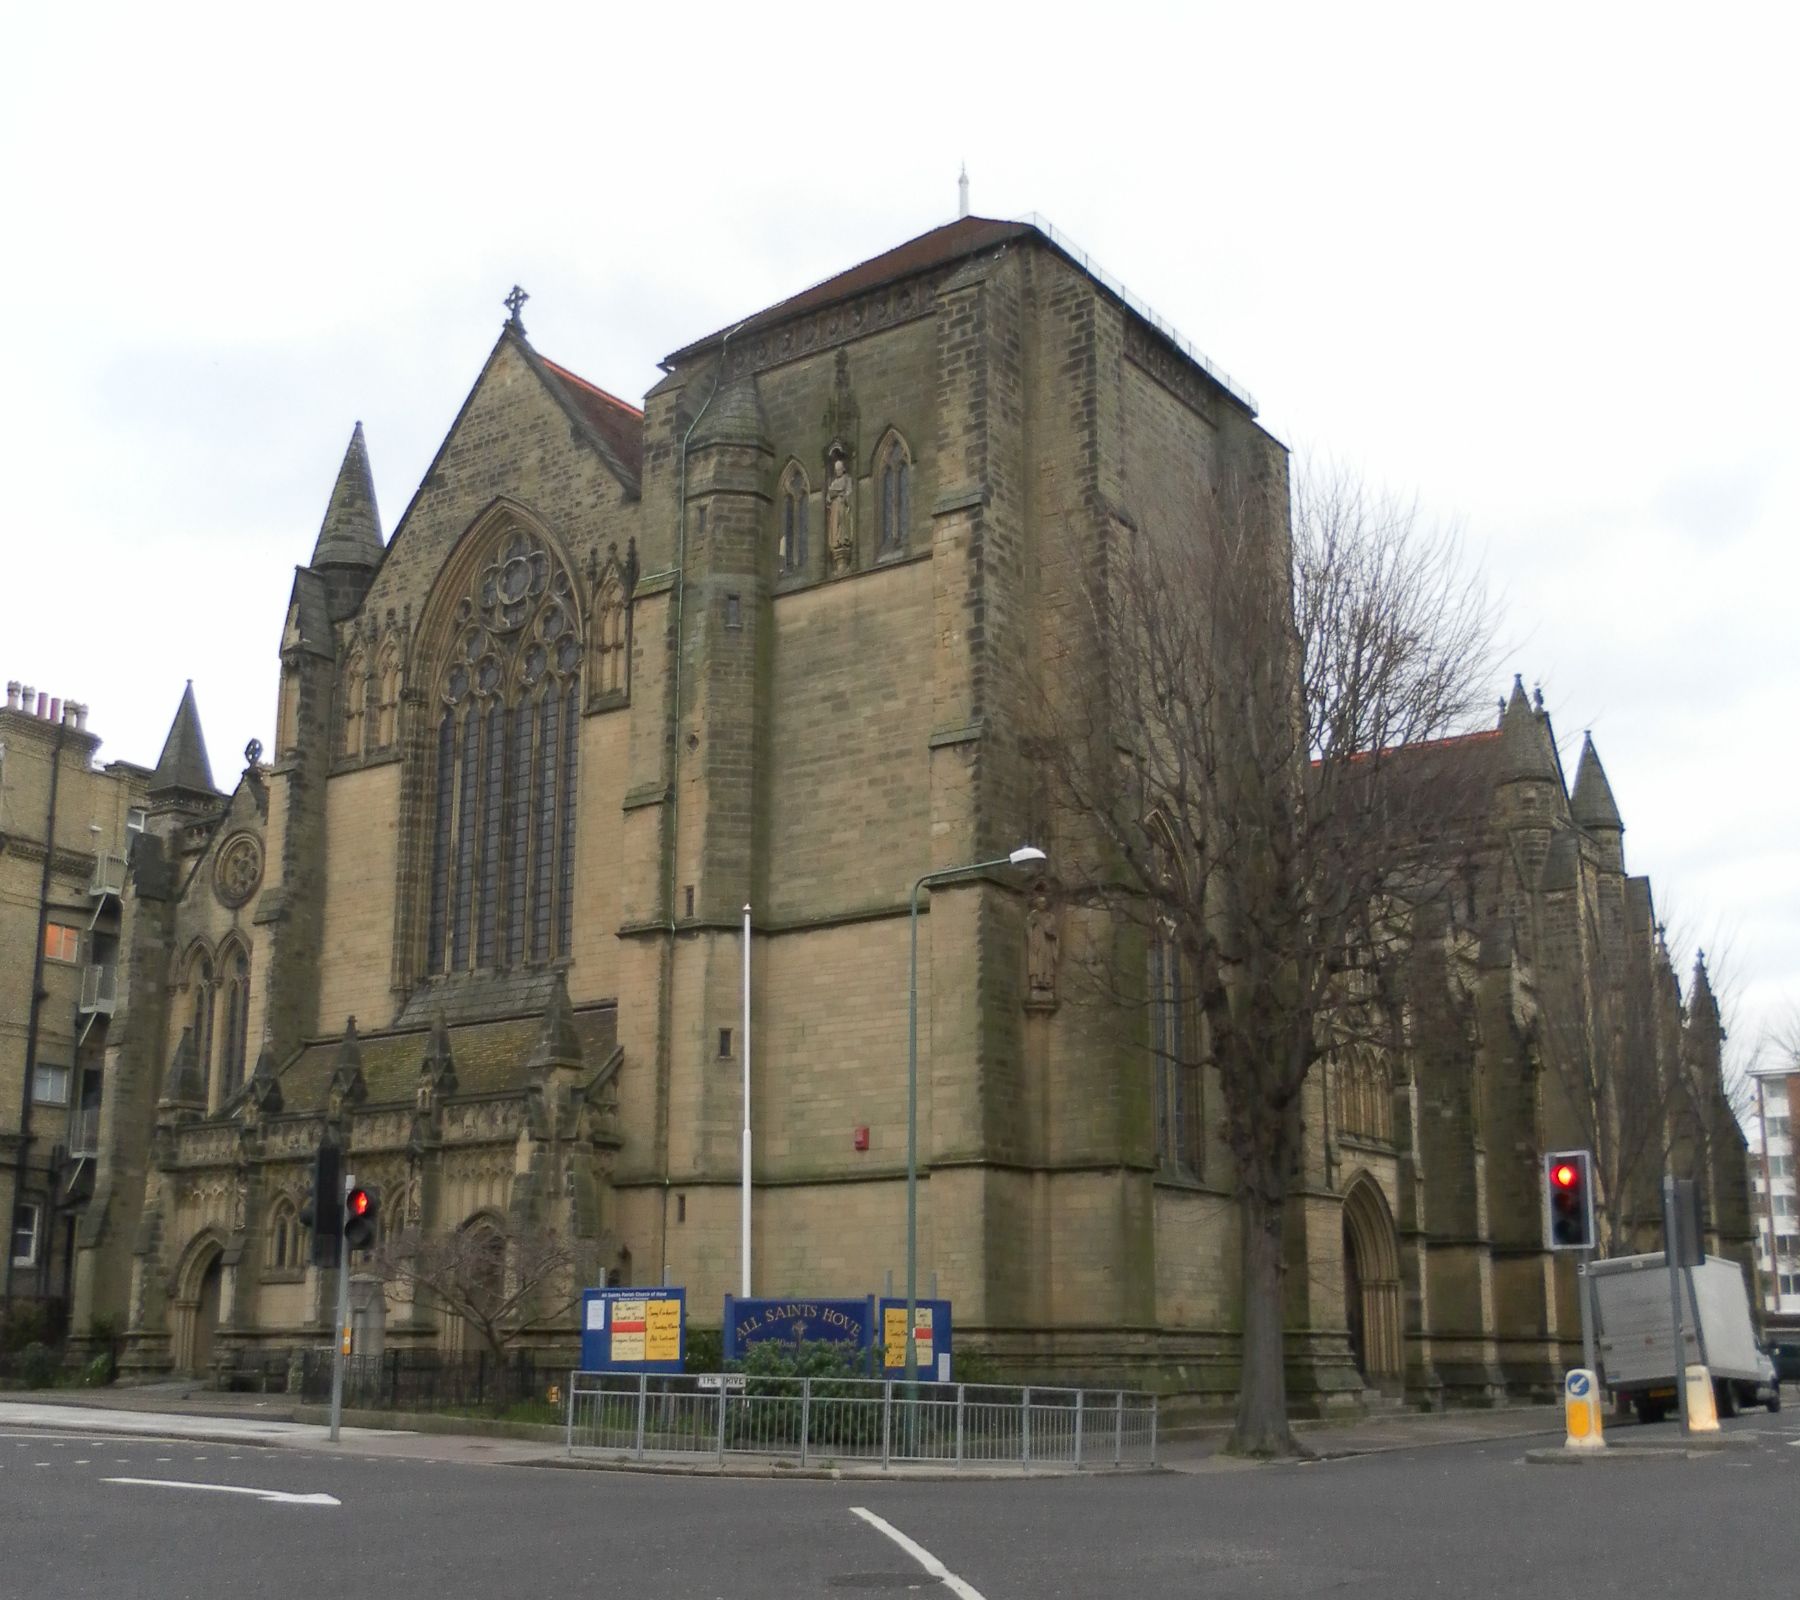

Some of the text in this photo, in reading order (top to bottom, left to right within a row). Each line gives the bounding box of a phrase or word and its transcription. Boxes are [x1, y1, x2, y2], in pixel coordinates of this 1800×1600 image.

[736, 1304, 862, 1340] ALL SAINTS HOVE
[703, 1376, 744, 1385] THE RIVE
